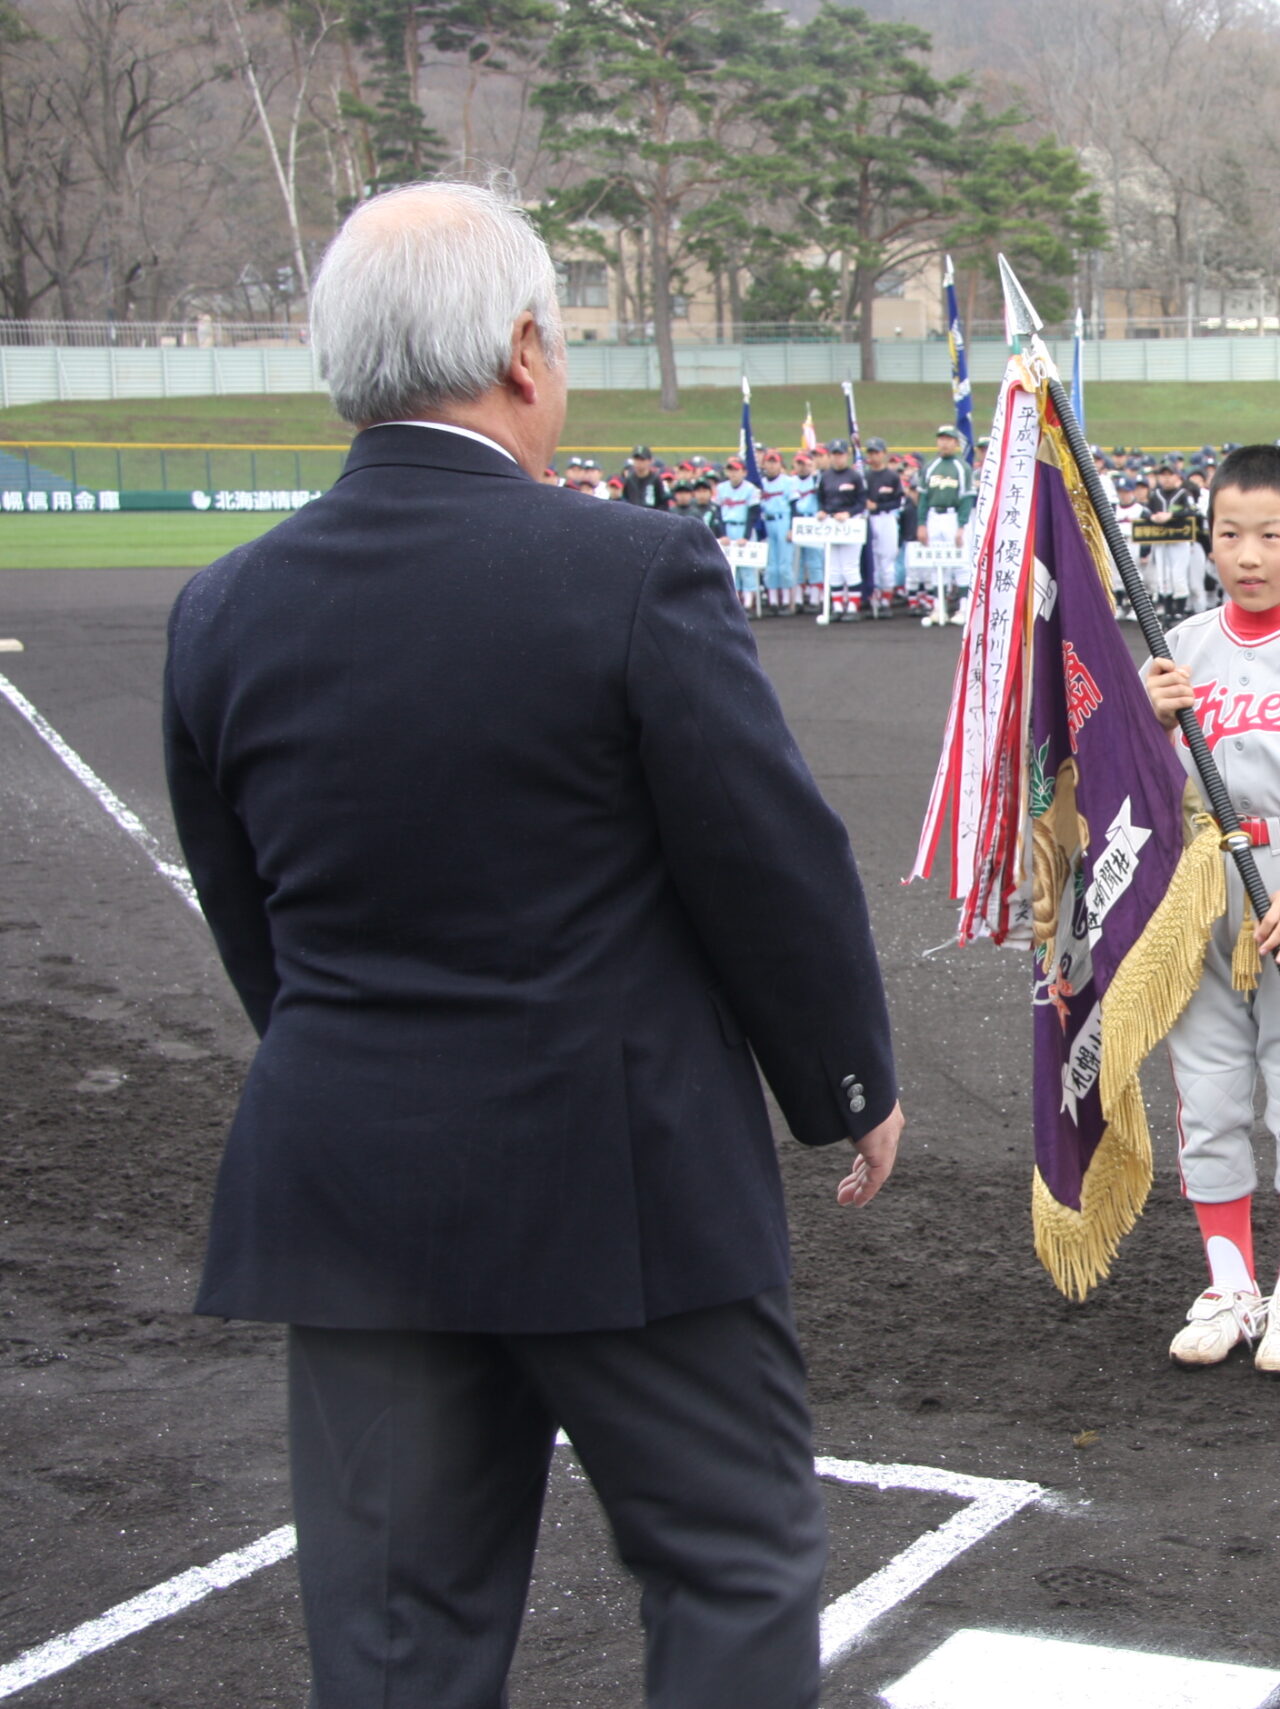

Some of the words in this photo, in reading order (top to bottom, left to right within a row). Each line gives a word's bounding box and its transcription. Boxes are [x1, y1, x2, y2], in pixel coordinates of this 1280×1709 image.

[1001, 406, 1036, 529] 平成二十一年度
[0, 491, 120, 511] 幌信用金庫
[993, 540, 1021, 592] 優勝
